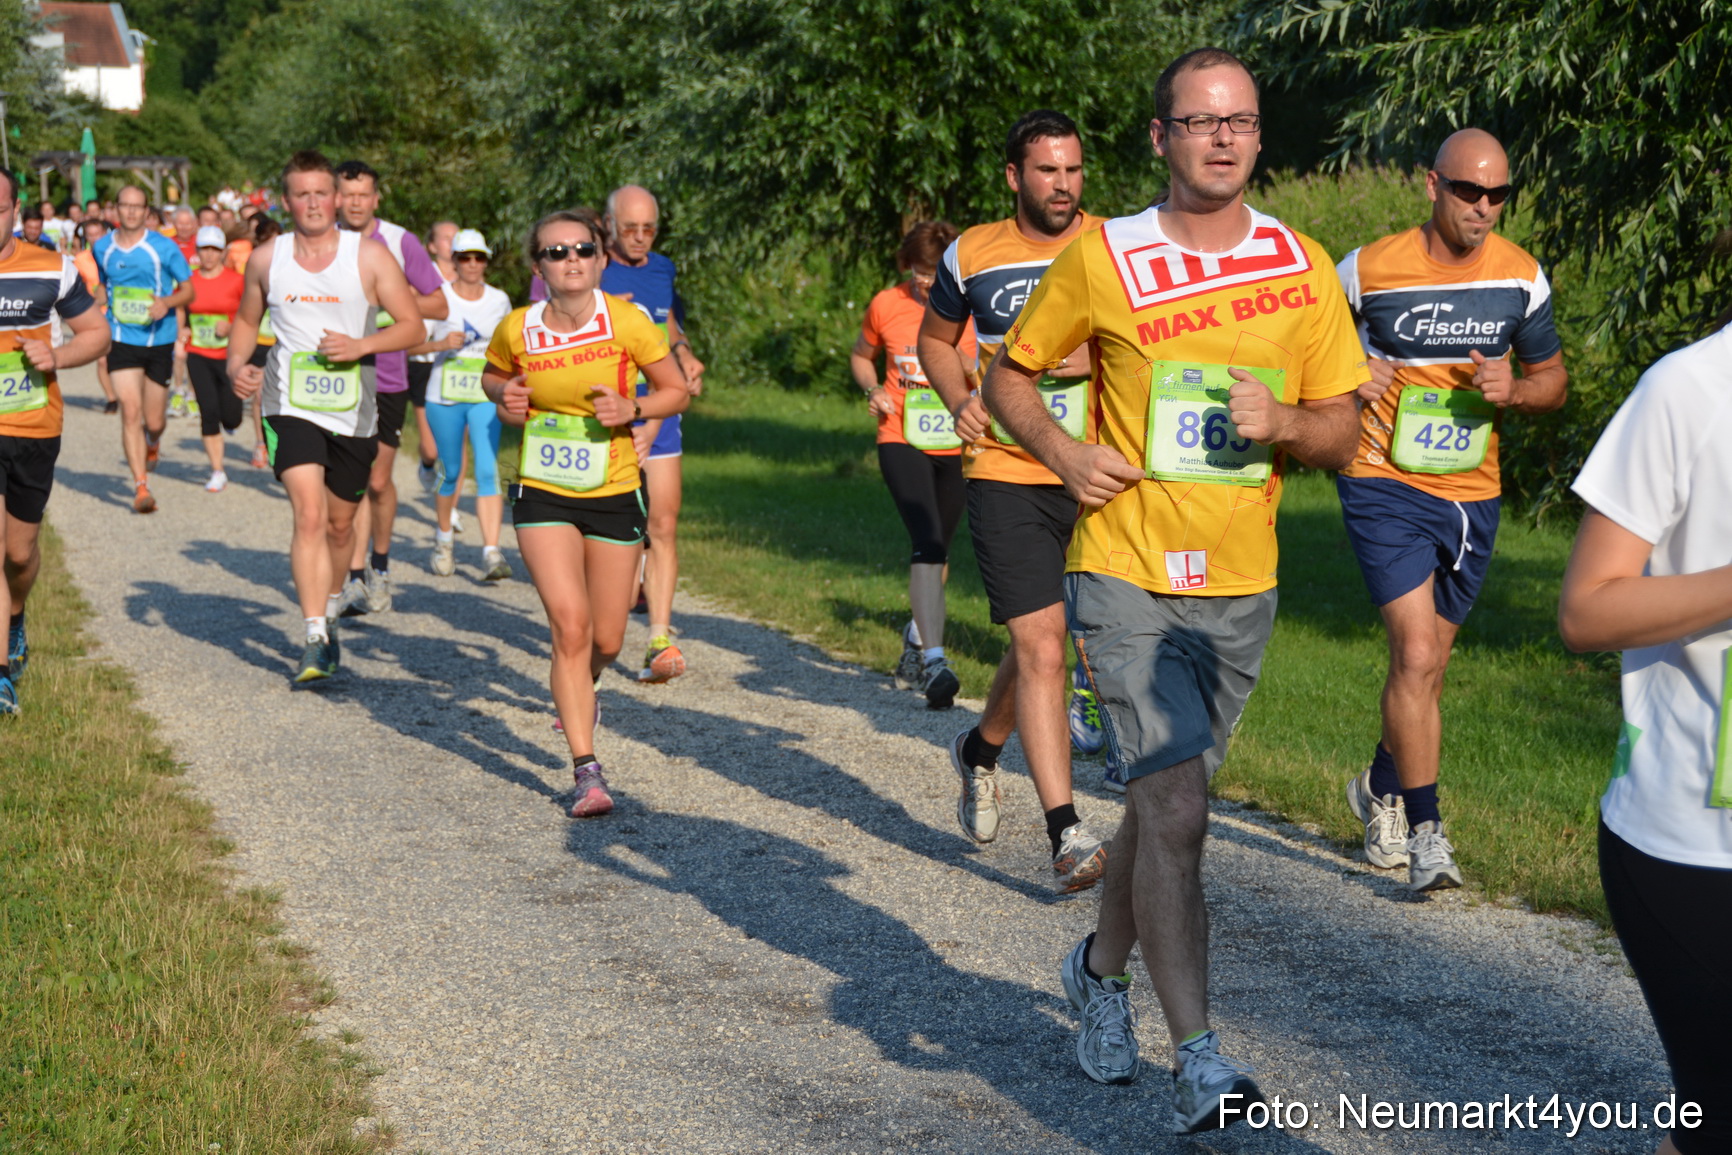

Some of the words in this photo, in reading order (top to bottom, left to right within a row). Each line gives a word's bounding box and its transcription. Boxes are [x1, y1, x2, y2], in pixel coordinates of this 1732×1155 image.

[1136, 305, 1222, 346] MAX
[1231, 282, 1318, 322] BÖGL
[1414, 317, 1506, 336] Fischer
[1423, 337, 1499, 345] AUTOMOBILE
[528, 358, 566, 372] MAX
[573, 346, 617, 365] BÖGL
[0, 375, 32, 397] 24
[306, 376, 345, 395] 590
[1414, 423, 1472, 452] 428
[540, 444, 590, 471] 938
[1179, 457, 1212, 466] Matthias
[1213, 460, 1245, 469] Auhuber
